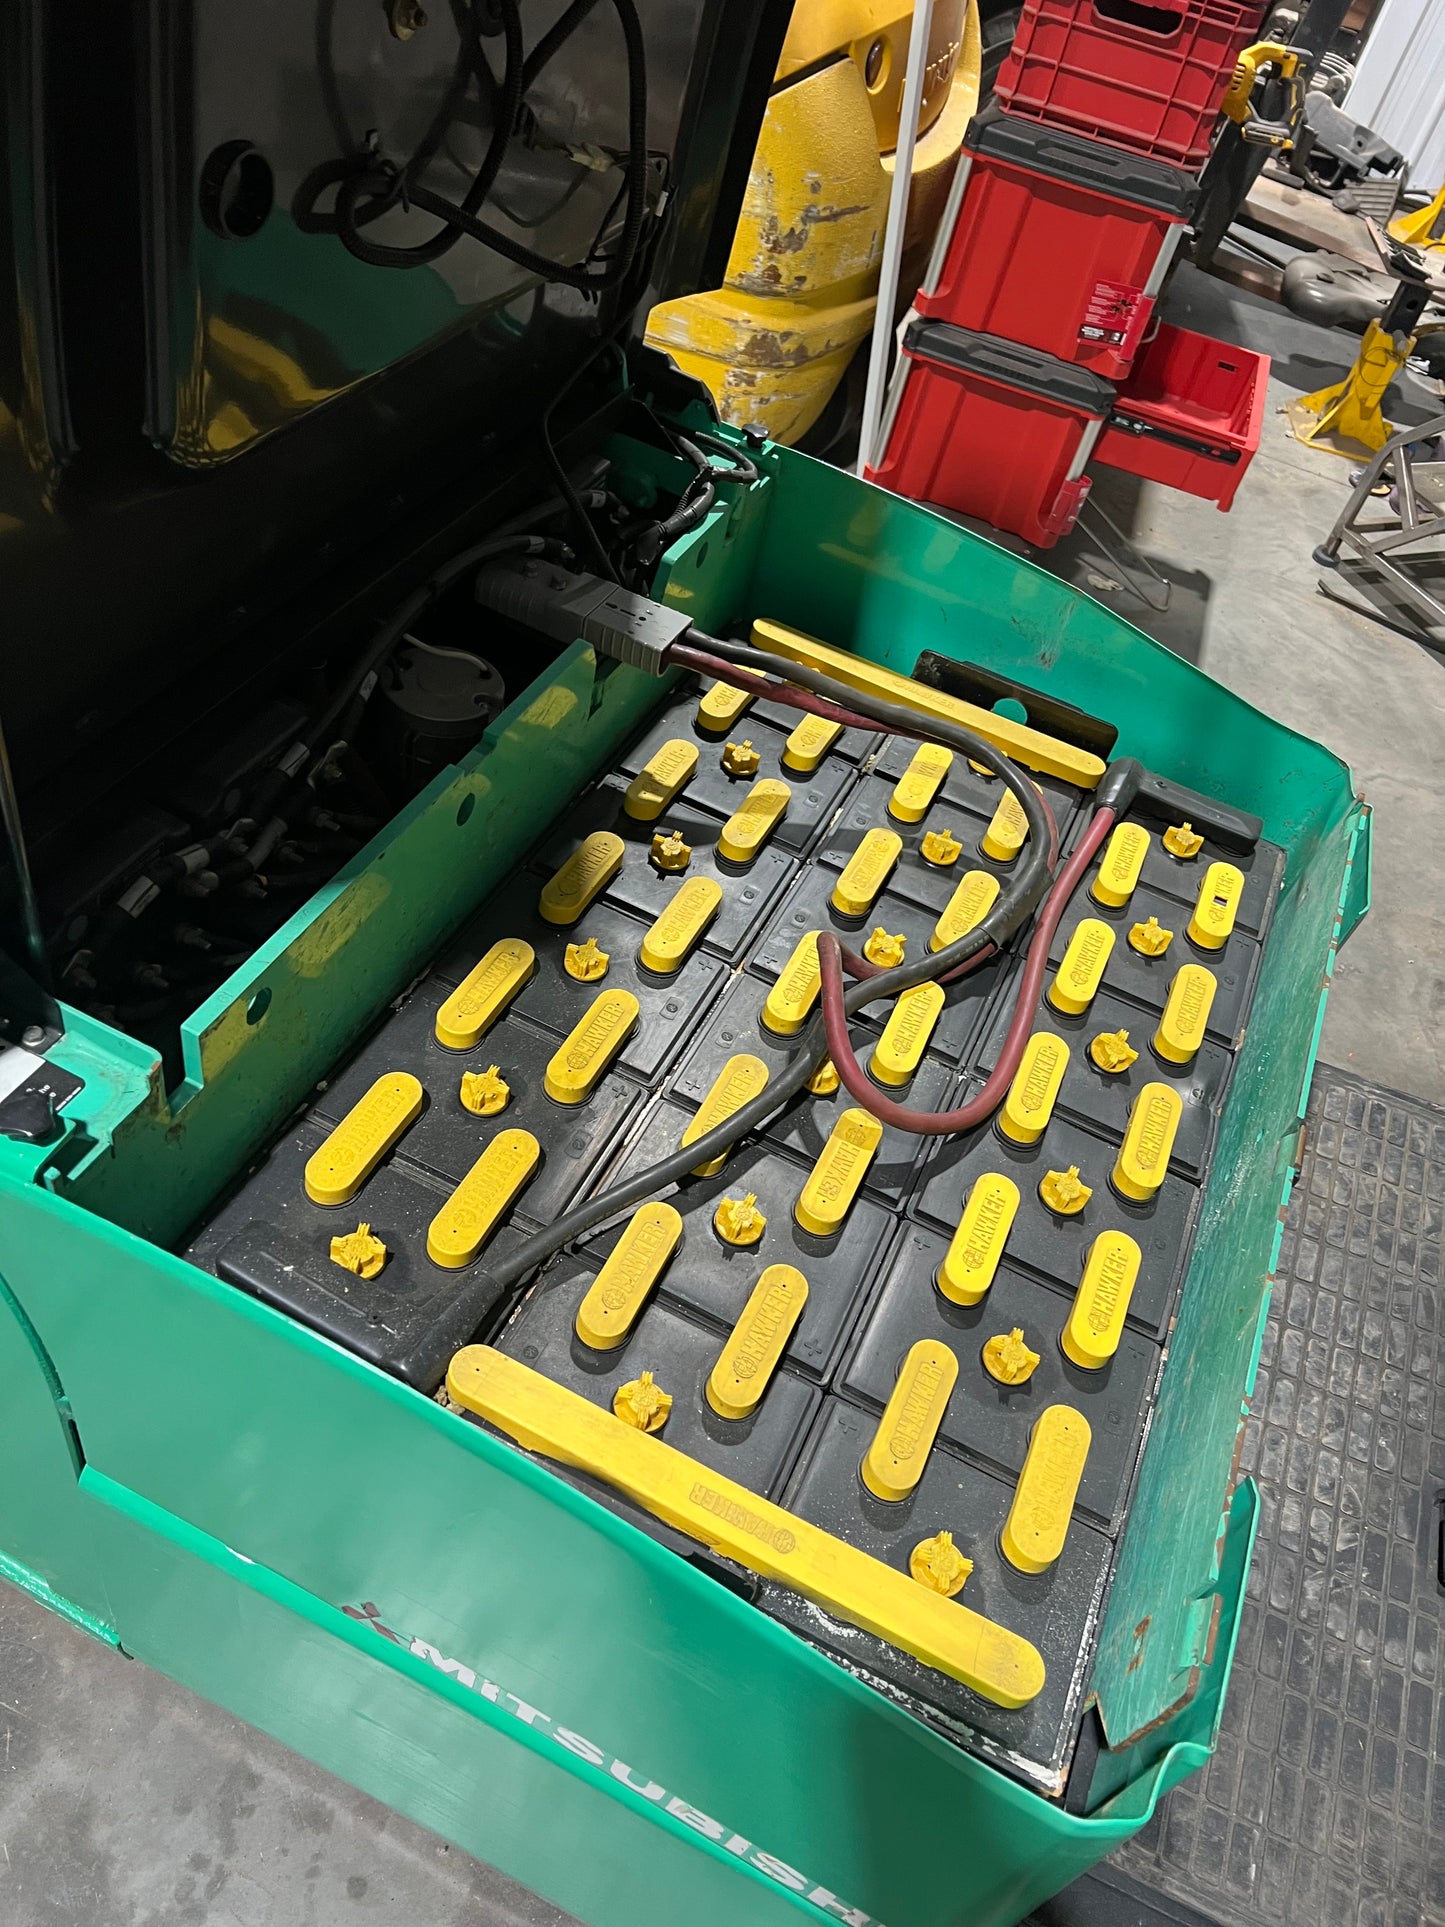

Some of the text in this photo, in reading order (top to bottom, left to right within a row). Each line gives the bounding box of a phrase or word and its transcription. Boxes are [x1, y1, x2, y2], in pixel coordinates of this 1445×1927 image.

[568, 843, 614, 889] HAWKER
[1115, 832, 1141, 877] HAWKER
[469, 952, 521, 1005] HAWKER
[1075, 931, 1105, 979] HAWKER
[575, 1003, 626, 1058] HAWKER
[898, 992, 934, 1046] HAWKER
[1180, 977, 1207, 1026] HAWKER
[1026, 1046, 1059, 1101] HAWKER
[1141, 1098, 1172, 1162] HAWKER
[817, 1142, 860, 1201] HAWKER
[968, 1191, 1006, 1250] HAWKER
[610, 1221, 666, 1290] HAWKER
[1093, 1249, 1128, 1320] HAWKER
[743, 1286, 793, 1362] HAWKER
[897, 1361, 944, 1443] HAWKER
[689, 1483, 776, 1545] HAWKER
[410, 1636, 887, 1927] MITSUBISH
